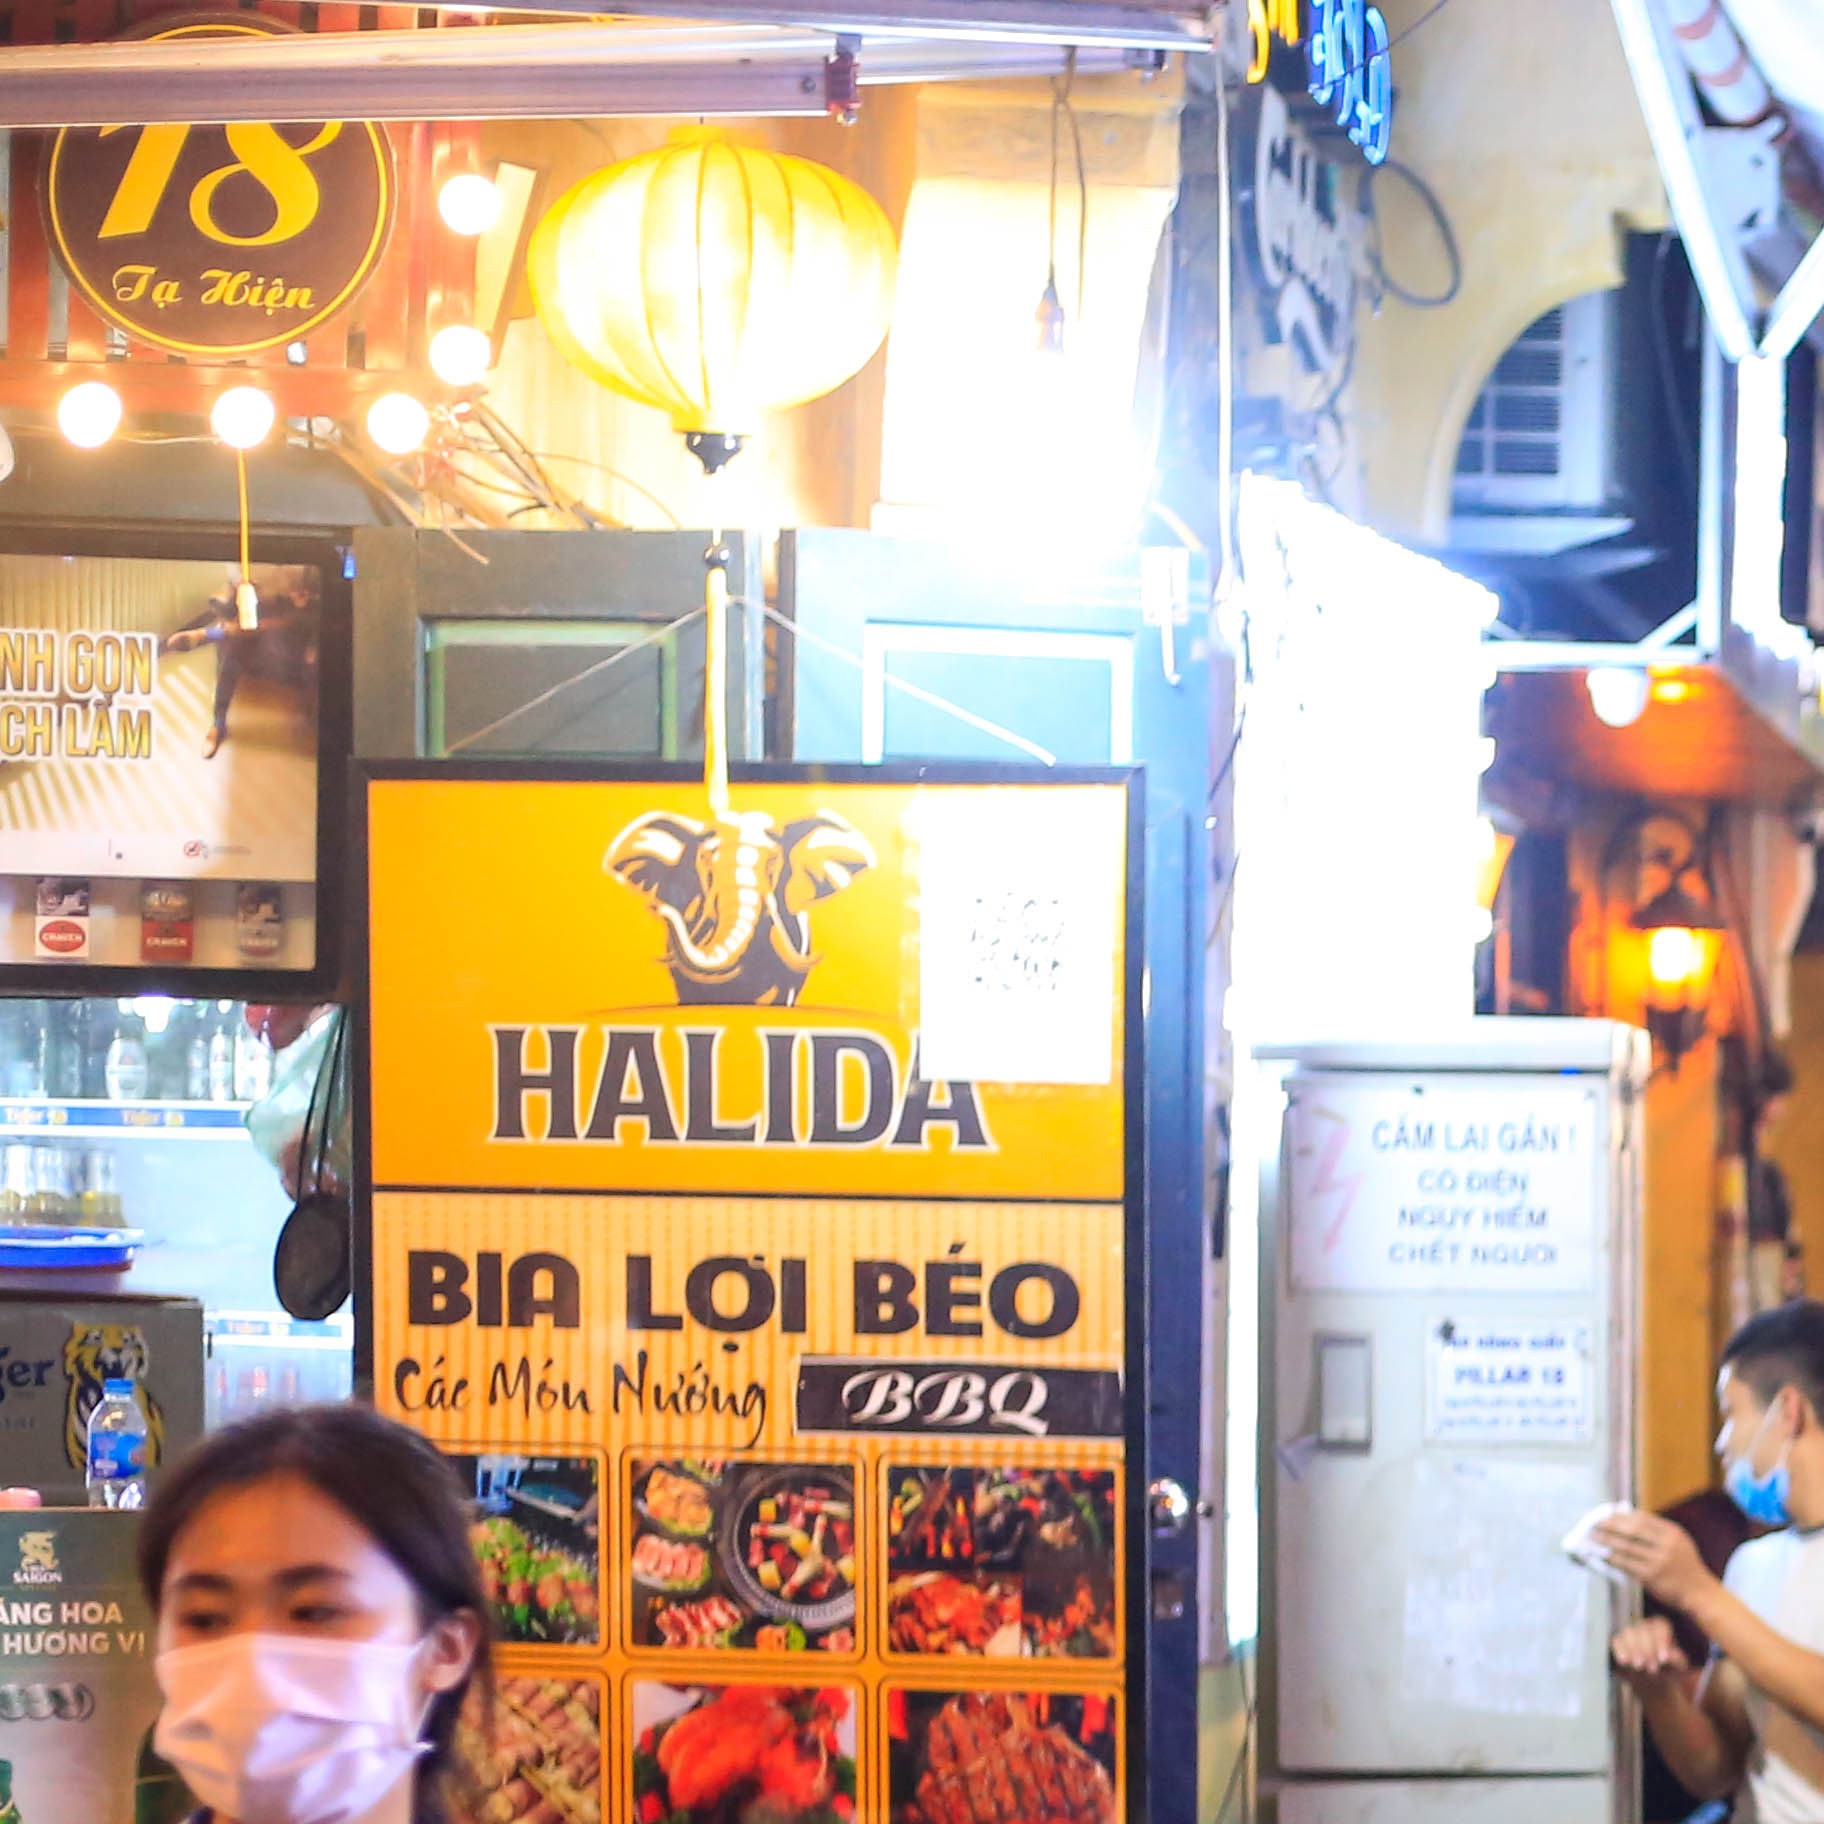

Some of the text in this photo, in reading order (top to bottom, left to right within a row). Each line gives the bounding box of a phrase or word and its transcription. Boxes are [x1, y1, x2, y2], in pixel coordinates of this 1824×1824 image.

[112, 264, 315, 316] Tạ Hiện
[486, 1024, 998, 1151] HALIDA
[408, 1241, 1081, 1352] BIA LỢI BÉO
[395, 1349, 768, 1450] Các Món Nướng
[841, 1369, 1050, 1437] BBQ
[60, 1600, 124, 1625] HOA
